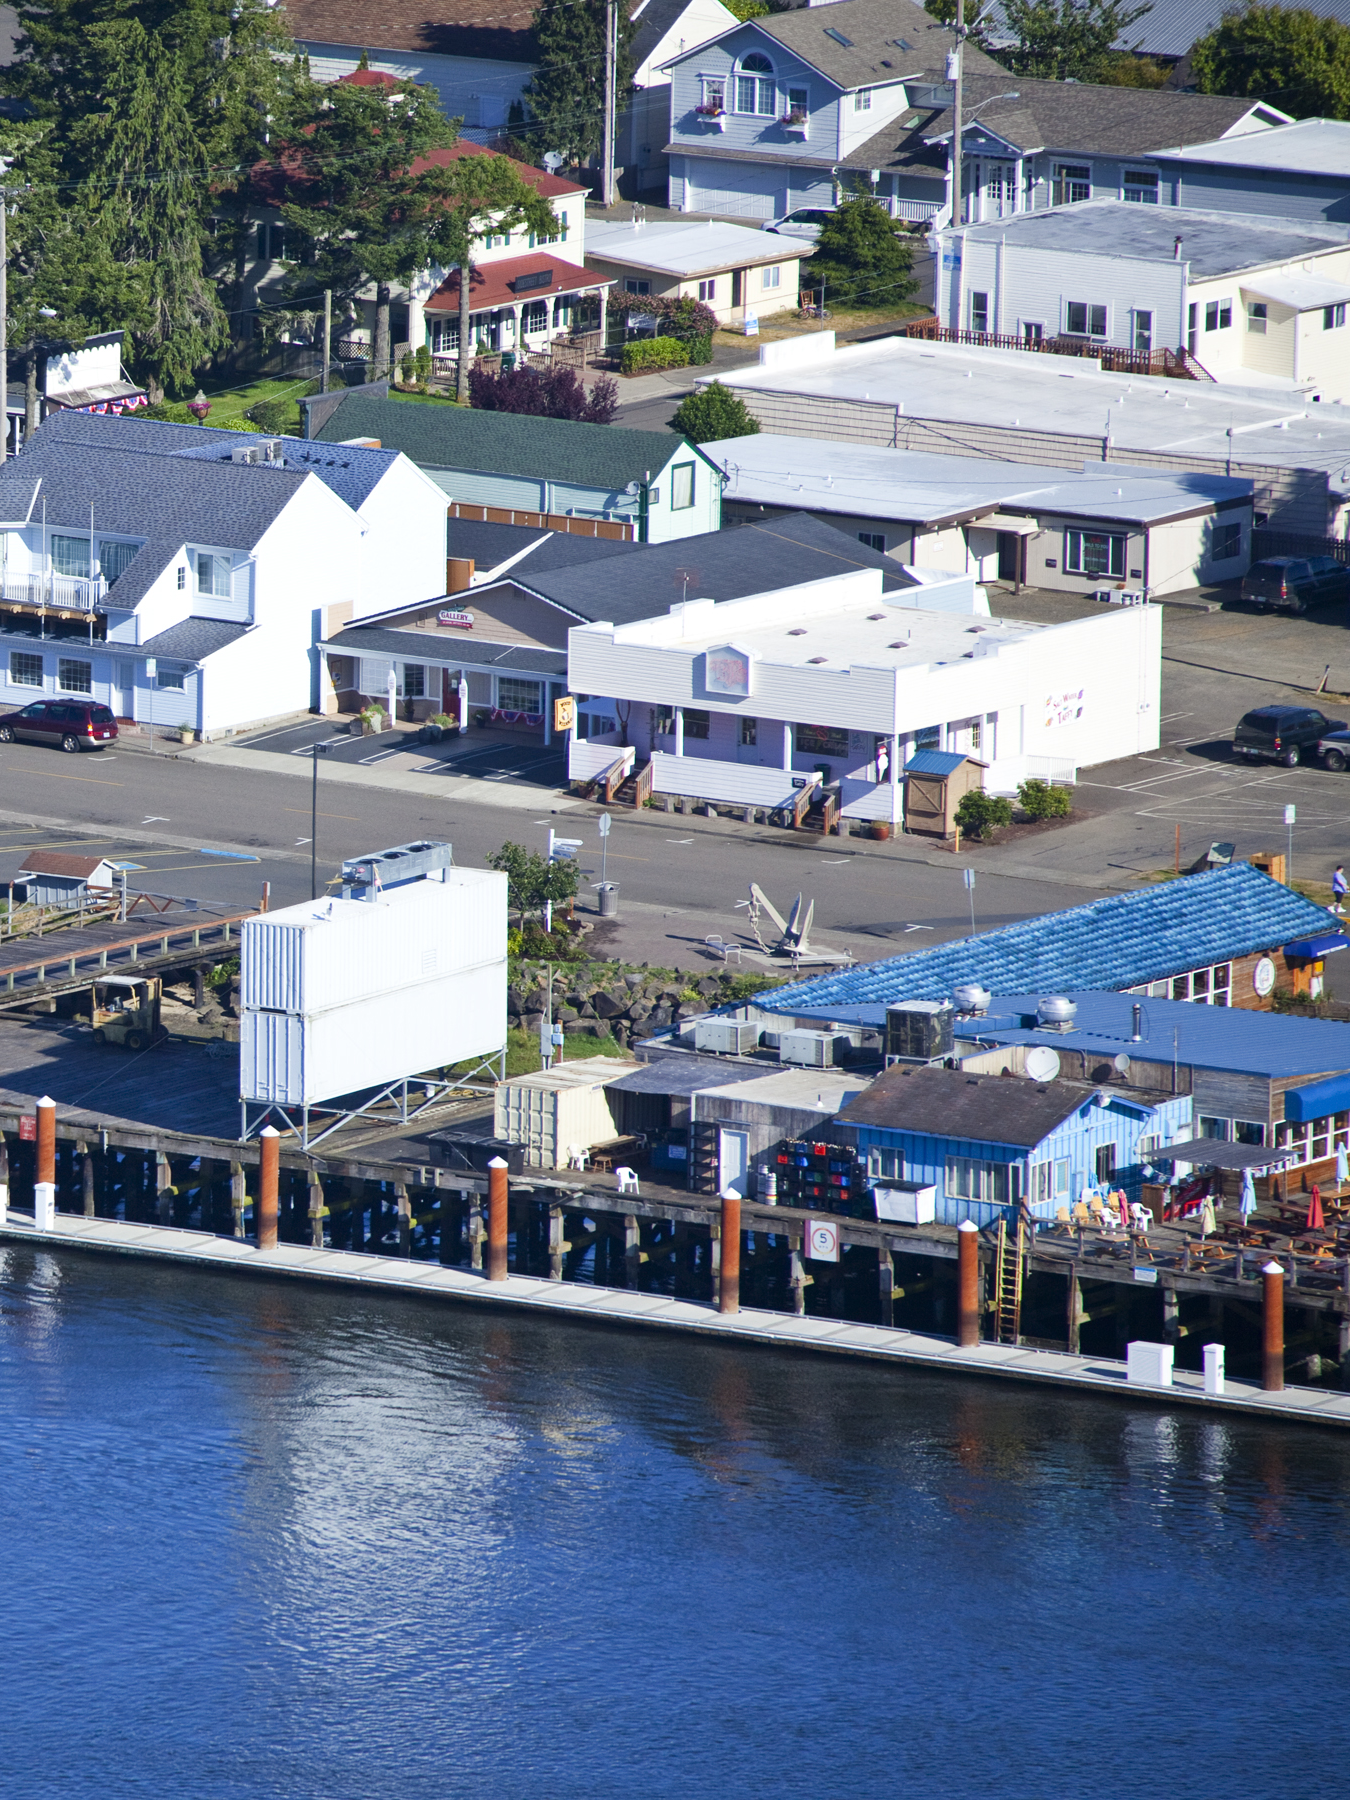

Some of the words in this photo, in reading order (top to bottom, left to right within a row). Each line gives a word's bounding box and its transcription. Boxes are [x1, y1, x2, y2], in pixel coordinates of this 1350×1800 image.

[441, 611, 469, 621] GALLERY
[1057, 709, 1073, 724] TAFFY
[820, 1233, 827, 1244] 5
